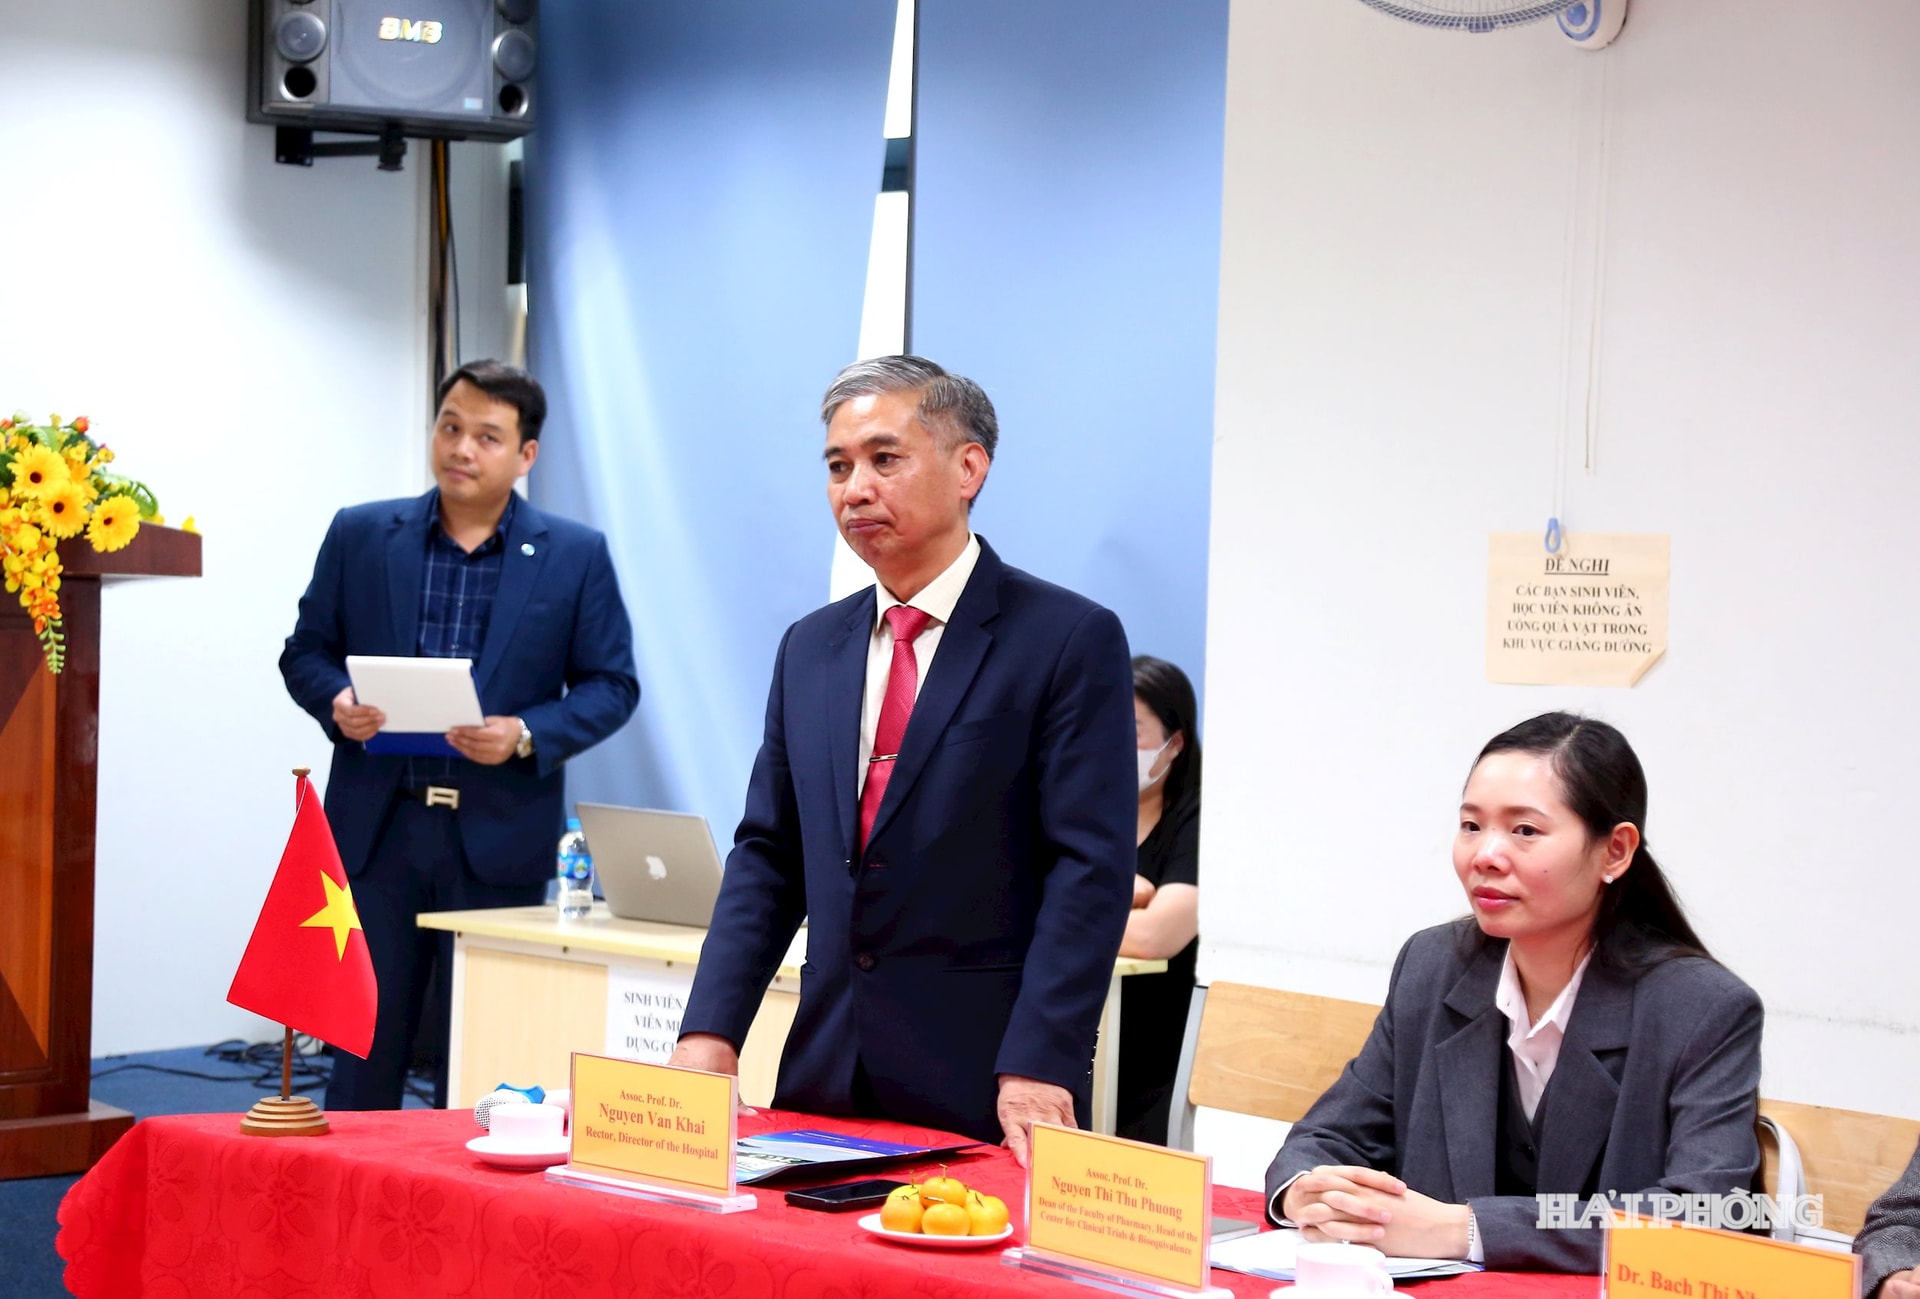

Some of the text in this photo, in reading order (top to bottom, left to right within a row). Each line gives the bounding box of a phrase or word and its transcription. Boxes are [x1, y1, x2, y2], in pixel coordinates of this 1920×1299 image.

[379, 17, 443, 44] BMB
[1516, 582, 1639, 600] CÁC BẠN SINH VIÊN,
[1512, 600, 1643, 617] HỌC VIÊN KHÔNG ĂN
[1601, 622, 1648, 636] TRONG
[1502, 637, 1527, 650] KHU
[1530, 638, 1556, 653] VỰC
[624, 991, 652, 1006] SINH
[635, 1012, 662, 1030] VIÊN
[626, 1036, 659, 1053] DỤNG
[619, 1089, 682, 1110] Assoc. Prof. Dr.
[599, 1102, 705, 1135] Nguyen Van Khai
[585, 1125, 719, 1160] Rector, Director of the Hospital
[1086, 1168, 1149, 1191] Assoc. Prof. Dr.
[1052, 1176, 1183, 1222] Nguyen Thi Thu Phuong
[1039, 1197, 1198, 1243] Dean of the Faculty of Pharmacy, Head of the
[1040, 1210, 1193, 1256] Center for Clinical Trials & Bioequivalence
[1617, 1263, 1645, 1287] Dr.
[1650, 1270, 1693, 1297] Bach
[1699, 1281, 1729, 1299] Thi
